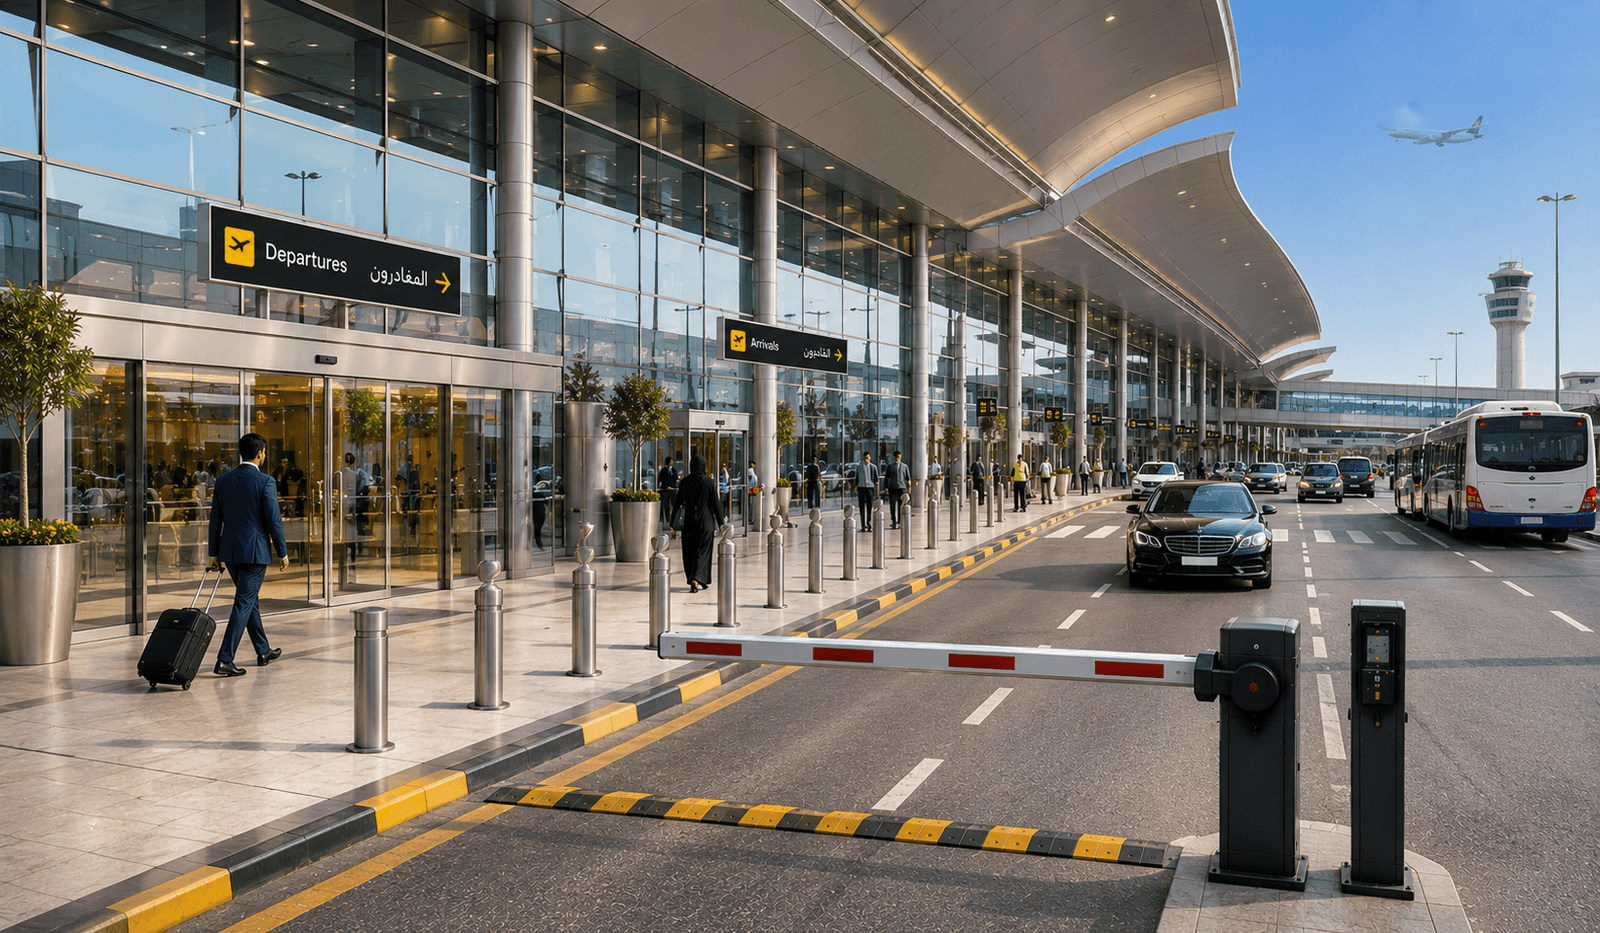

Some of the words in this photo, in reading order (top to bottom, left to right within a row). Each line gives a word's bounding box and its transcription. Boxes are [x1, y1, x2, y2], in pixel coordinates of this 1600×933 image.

[265, 242, 348, 274] Departures
[369, 266, 428, 287] المغادرون
[750, 337, 780, 352] Arrivals
